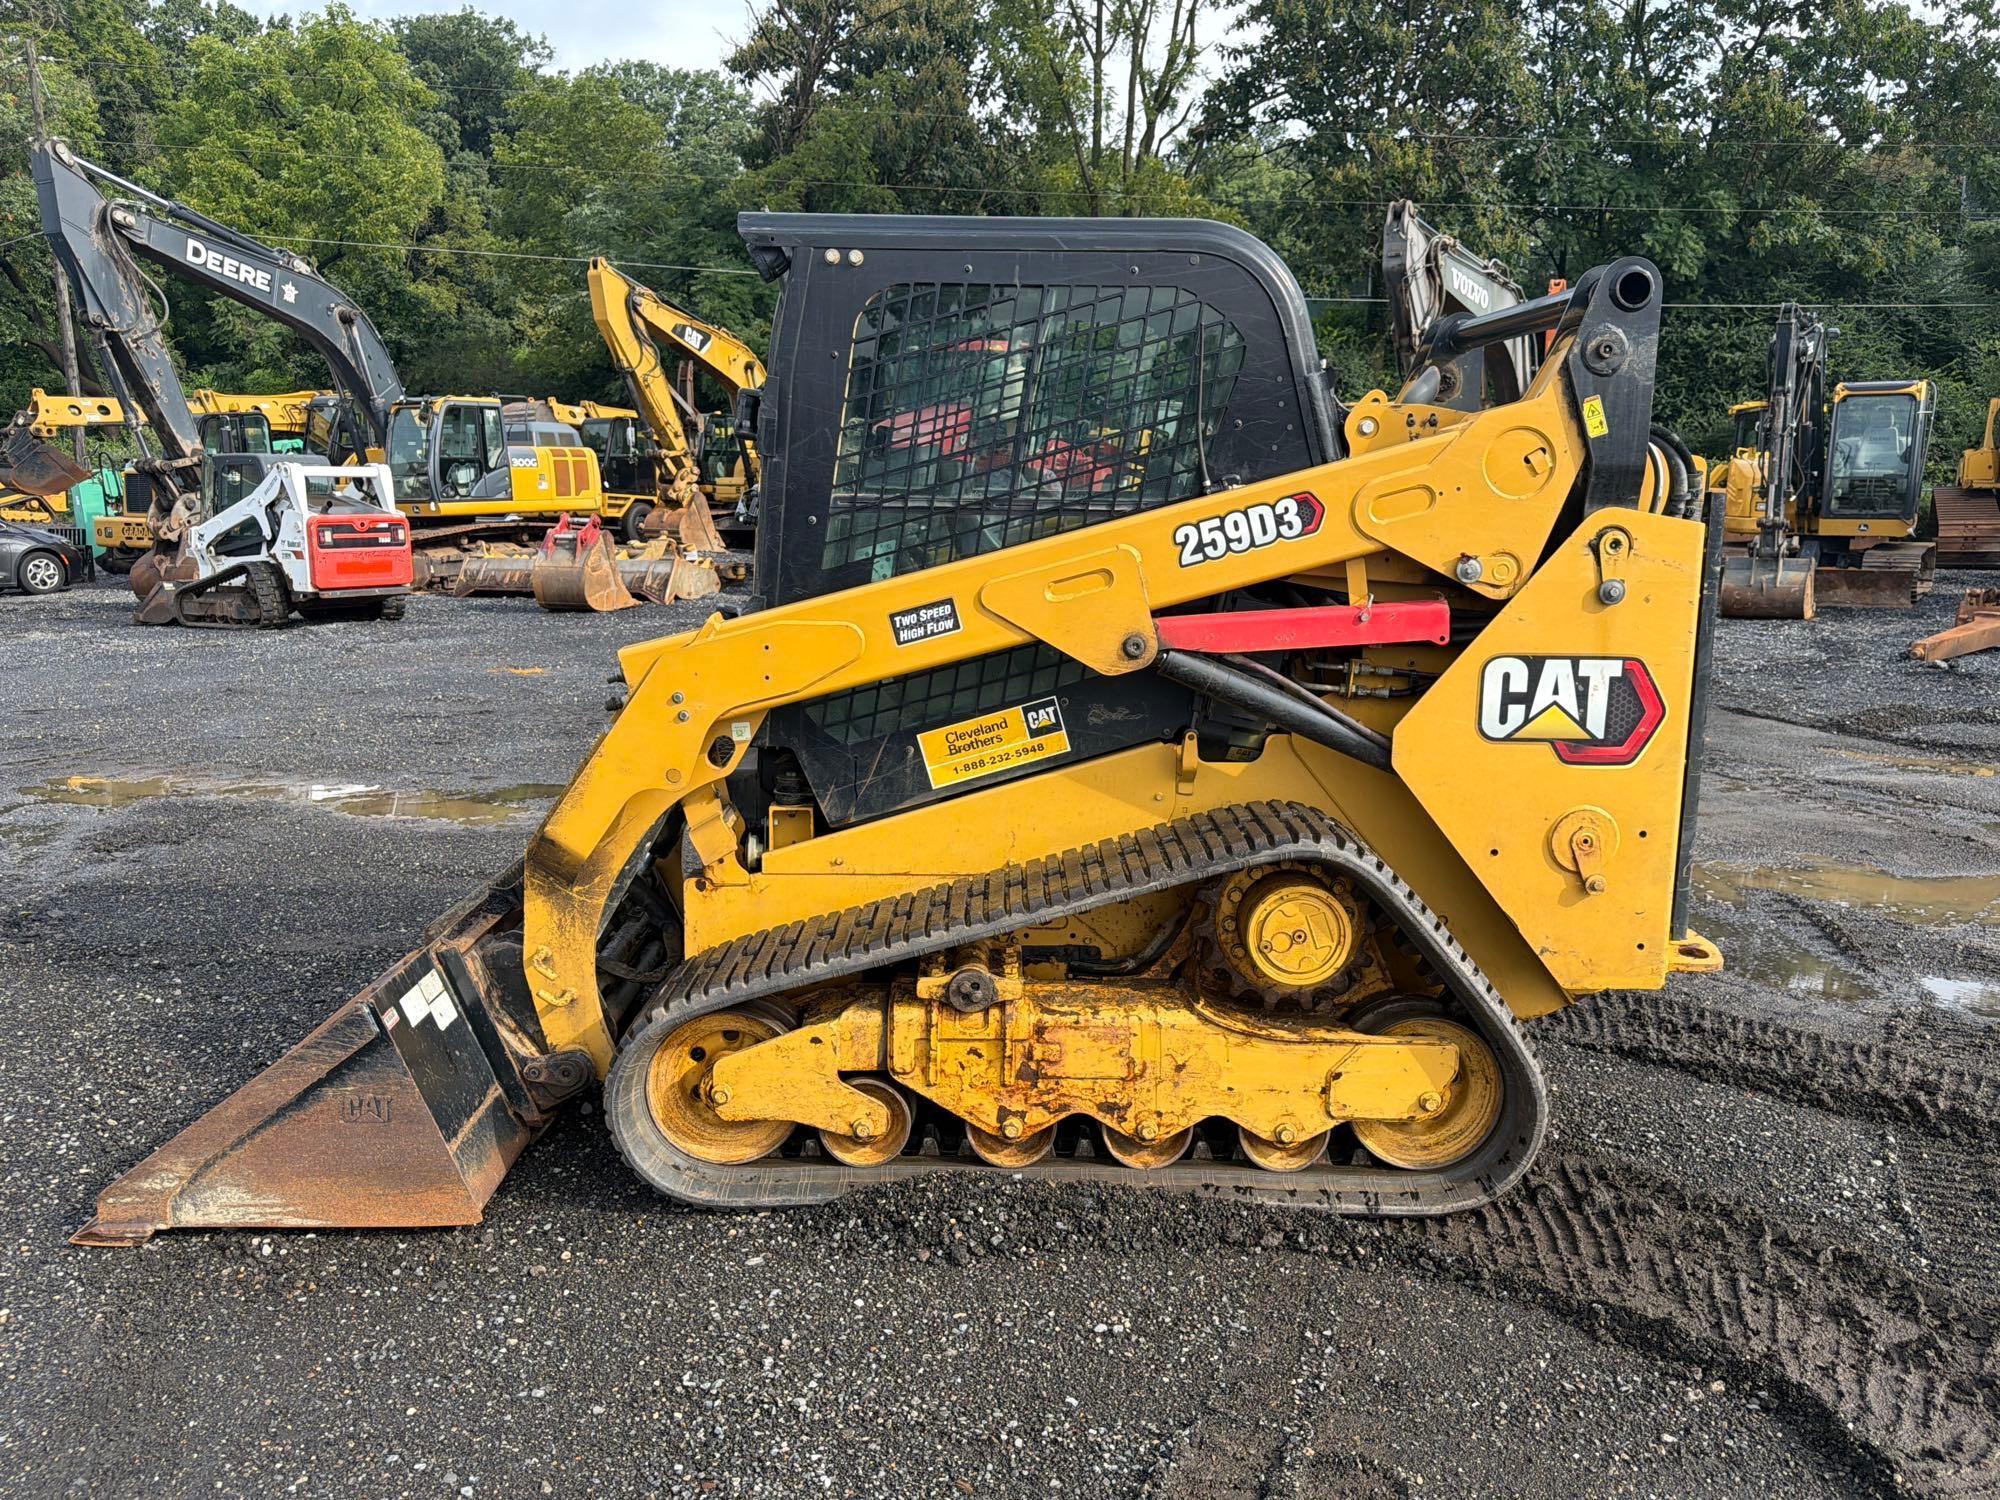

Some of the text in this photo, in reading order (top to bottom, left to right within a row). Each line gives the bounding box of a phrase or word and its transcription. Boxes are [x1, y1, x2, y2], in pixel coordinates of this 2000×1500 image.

[186, 238, 271, 292] DEERE
[1451, 267, 1489, 309] VOLVO
[684, 326, 704, 350] CAT
[511, 458, 538, 467] 300G
[1175, 498, 1303, 566] 259D3
[1481, 657, 1623, 739] CAT
[945, 717, 1008, 744] Cleveland
[1027, 706, 1056, 729] CAT
[947, 733, 1003, 756] Brothers
[953, 742, 1045, 775] 1-888-232-5948
[341, 1095, 392, 1122] CAT
